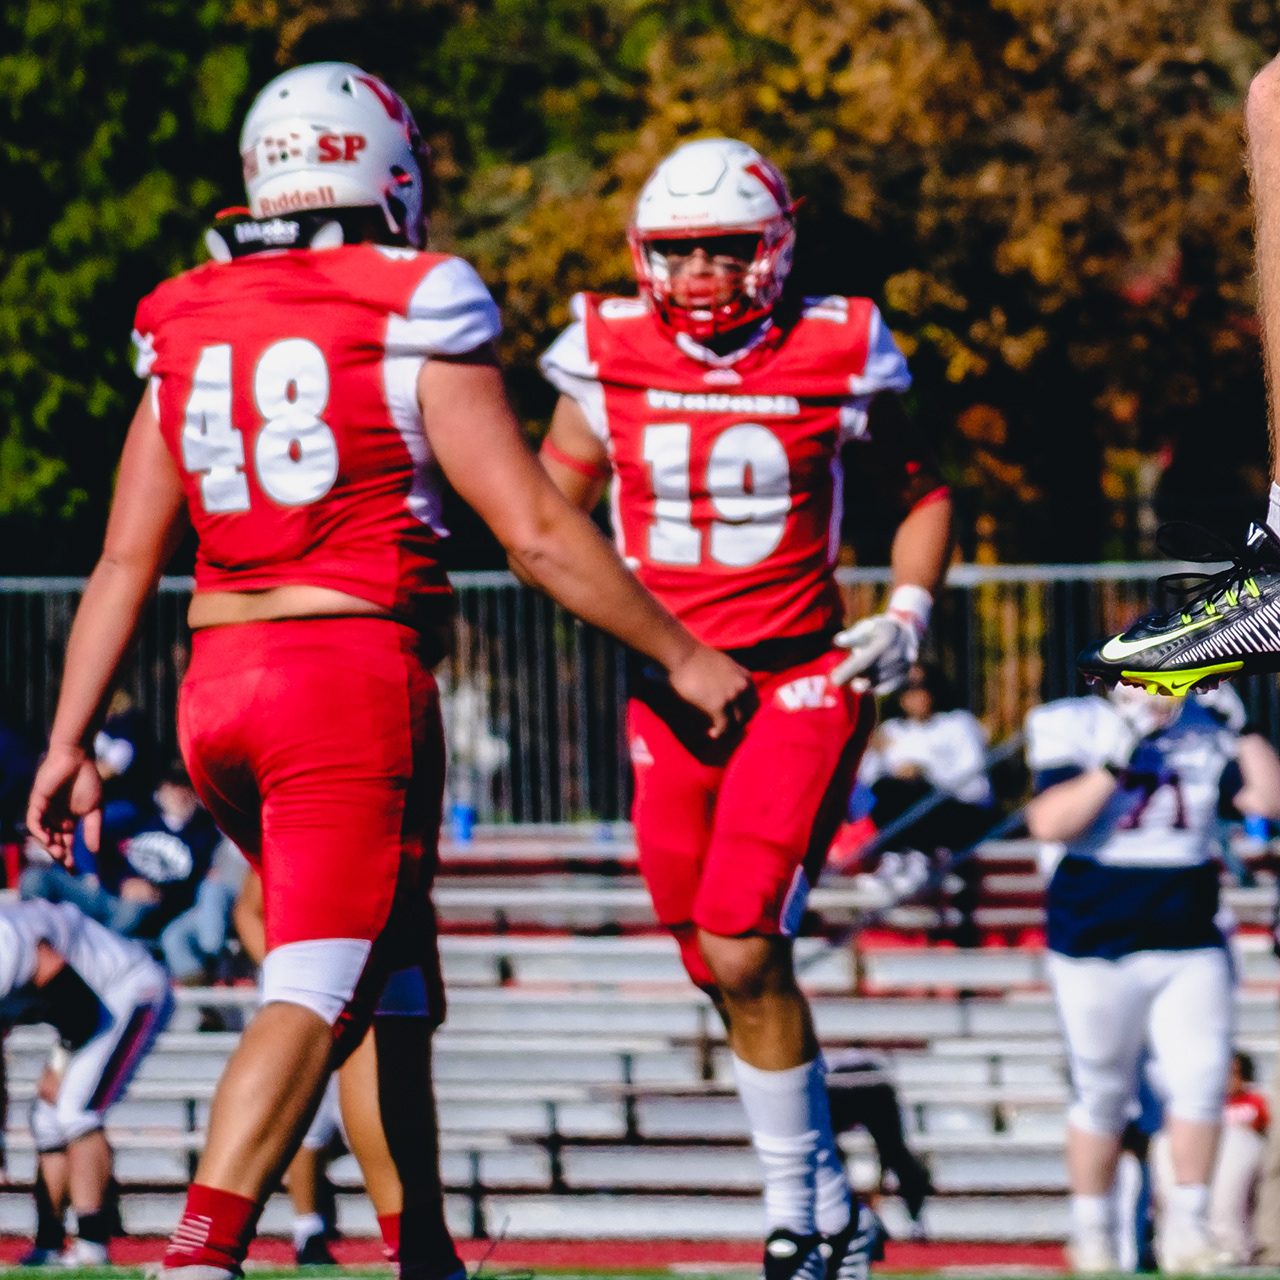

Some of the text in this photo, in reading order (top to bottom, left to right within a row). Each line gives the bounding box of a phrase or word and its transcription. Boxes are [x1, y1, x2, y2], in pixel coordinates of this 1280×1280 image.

[317, 134, 367, 163] SP
[259, 185, 336, 218] Riddell
[181, 337, 339, 513] 48
[643, 423, 792, 568] 19
